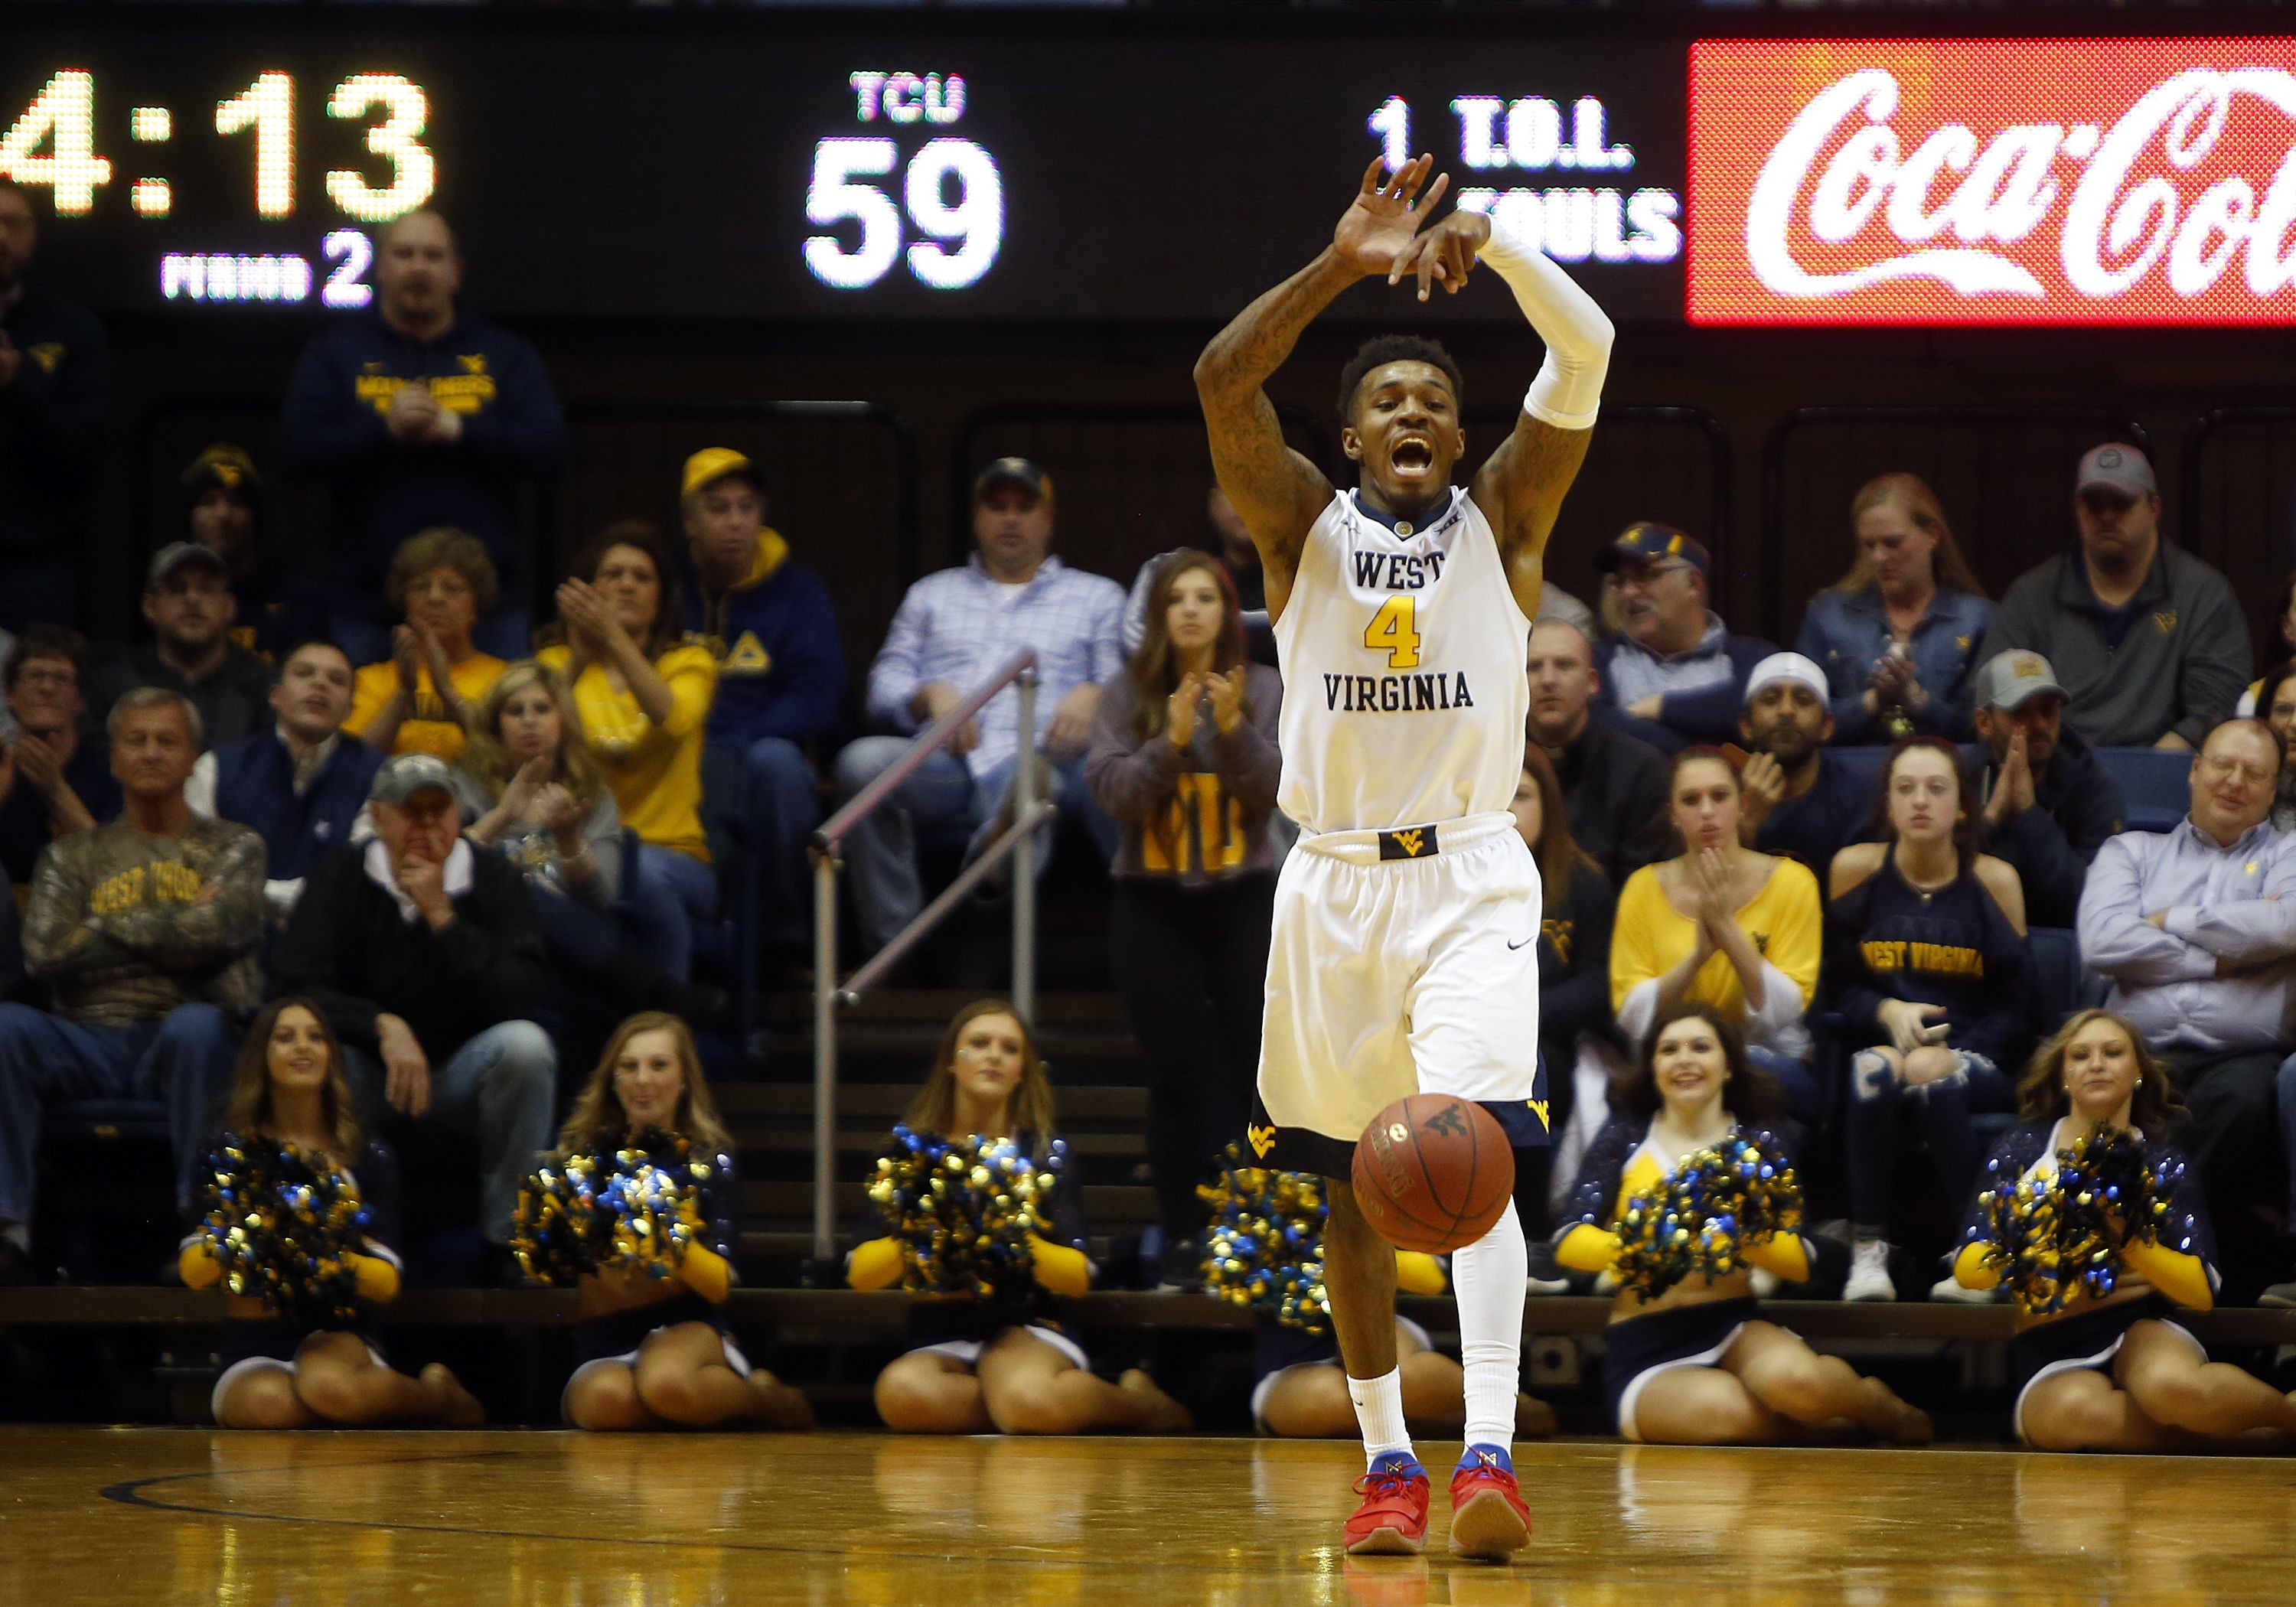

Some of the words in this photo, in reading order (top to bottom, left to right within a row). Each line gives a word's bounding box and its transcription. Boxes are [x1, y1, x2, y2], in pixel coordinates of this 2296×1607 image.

[850, 71, 967, 124] TCU
[1368, 95, 1412, 173] 1
[0, 69, 437, 223] 4:13
[802, 137, 1005, 289] 59
[321, 227, 374, 308] 2
[1354, 549, 1445, 589] WEST
[1364, 594, 1420, 668] 4
[1323, 671, 1474, 712] VIRGINIA
